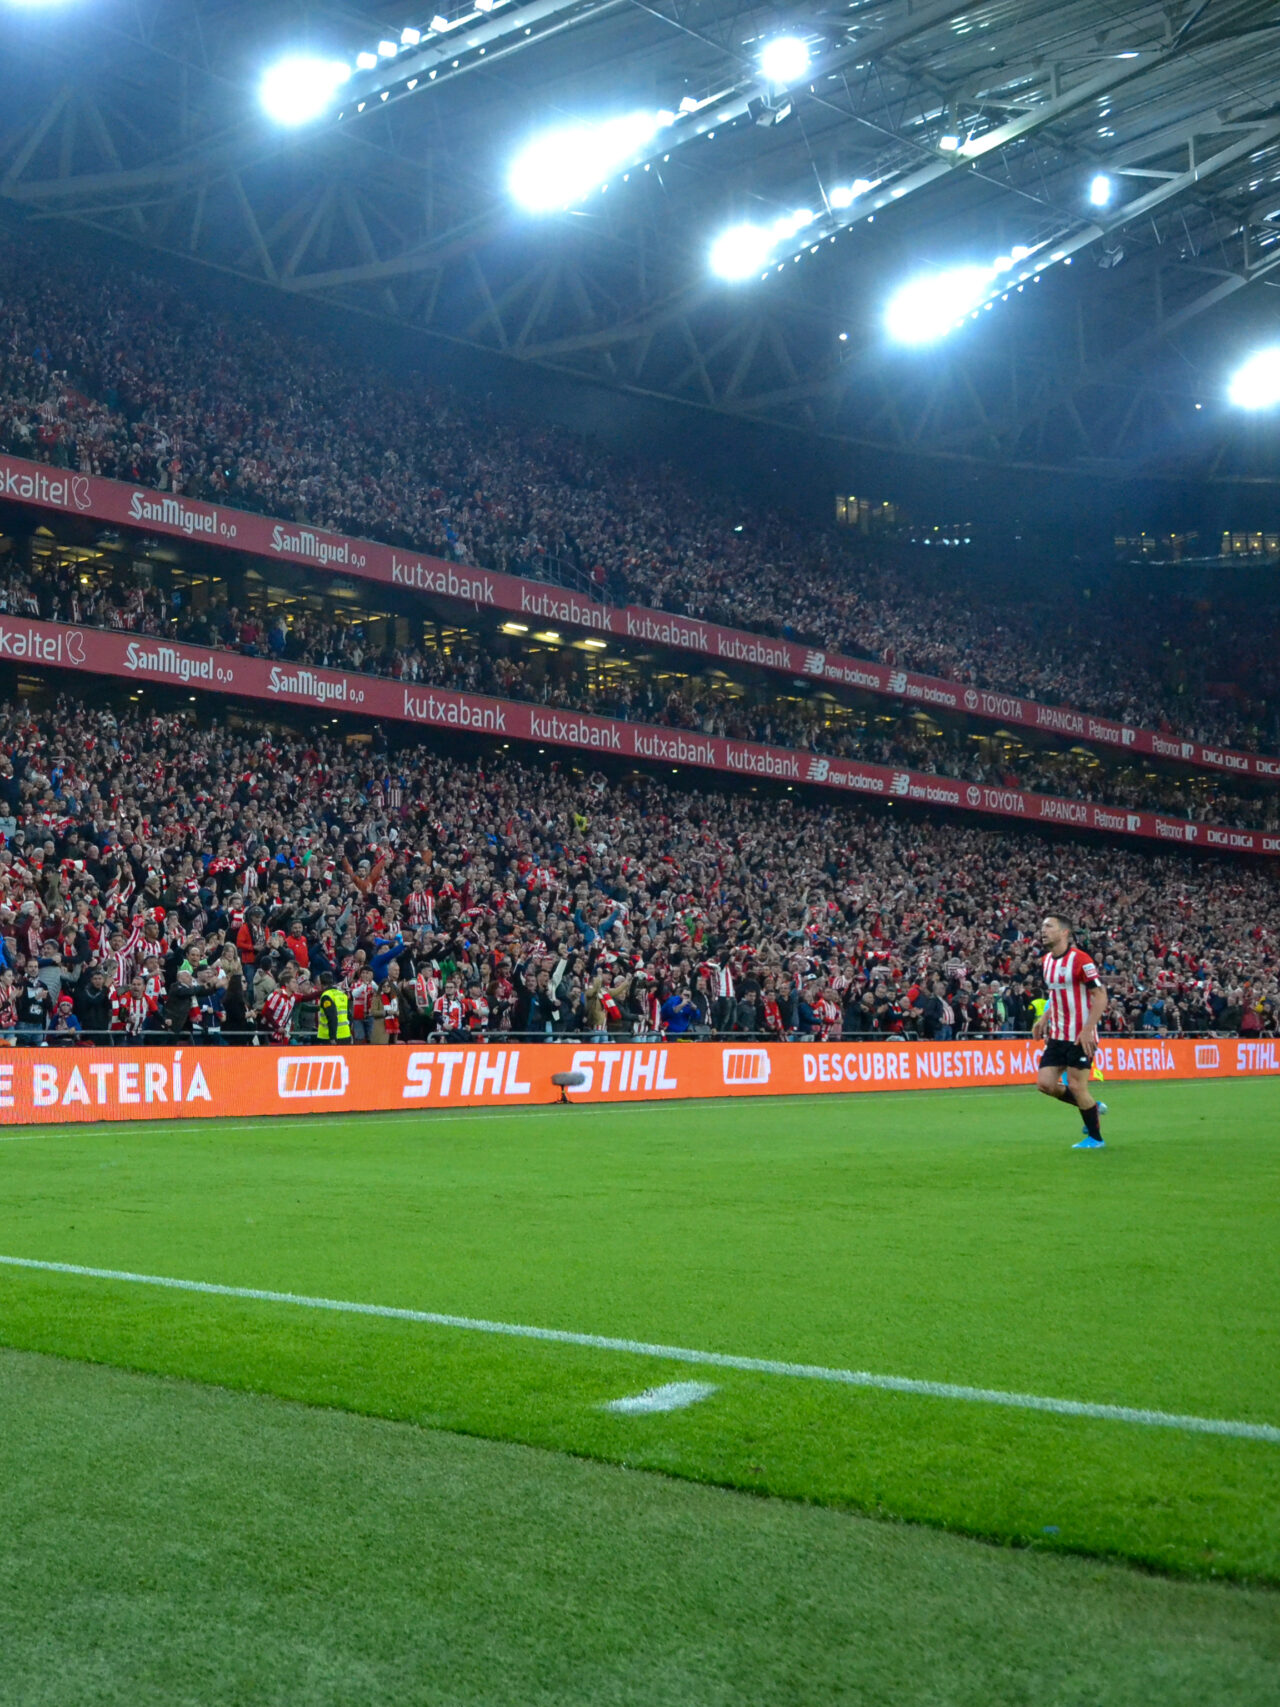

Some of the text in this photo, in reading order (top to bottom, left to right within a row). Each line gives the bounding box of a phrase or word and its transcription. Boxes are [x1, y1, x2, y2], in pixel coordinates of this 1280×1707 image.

[392, 555, 495, 605] kutxabank
[521, 586, 611, 631] kutxabank
[627, 612, 709, 652] kutxabank
[717, 633, 791, 669] kutxabank
[824, 664, 880, 689] new balance
[906, 684, 957, 706] new balance
[980, 694, 1023, 719] TOYOTA
[403, 688, 506, 733] kutxabank
[1035, 707, 1085, 733] JAPANCAR
[530, 710, 621, 750] kutxabank
[1088, 719, 1120, 743] Petronor
[634, 729, 715, 765] kutxabank
[1202, 749, 1224, 765] DIGI
[726, 744, 799, 778] kutxabank
[1225, 755, 1249, 770] DIGI
[828, 771, 885, 792] new balance
[909, 785, 960, 804] new balance
[983, 789, 1025, 814] TOYOTA
[1039, 800, 1088, 823] JAPANCAR
[1093, 809, 1126, 830] Petronor
[1207, 829, 1229, 845] DIGI
[1229, 833, 1254, 848] DIGI
[803, 1051, 910, 1082] DESCUBRE
[916, 1049, 1007, 1079] NUESTRAS
[1094, 1041, 1177, 1071] DE BATERÍA
[1236, 1043, 1280, 1071] STIHL
[33, 1050, 213, 1105] BATERÍA
[402, 1050, 531, 1098] STIHL
[567, 1049, 678, 1093] STIHL
